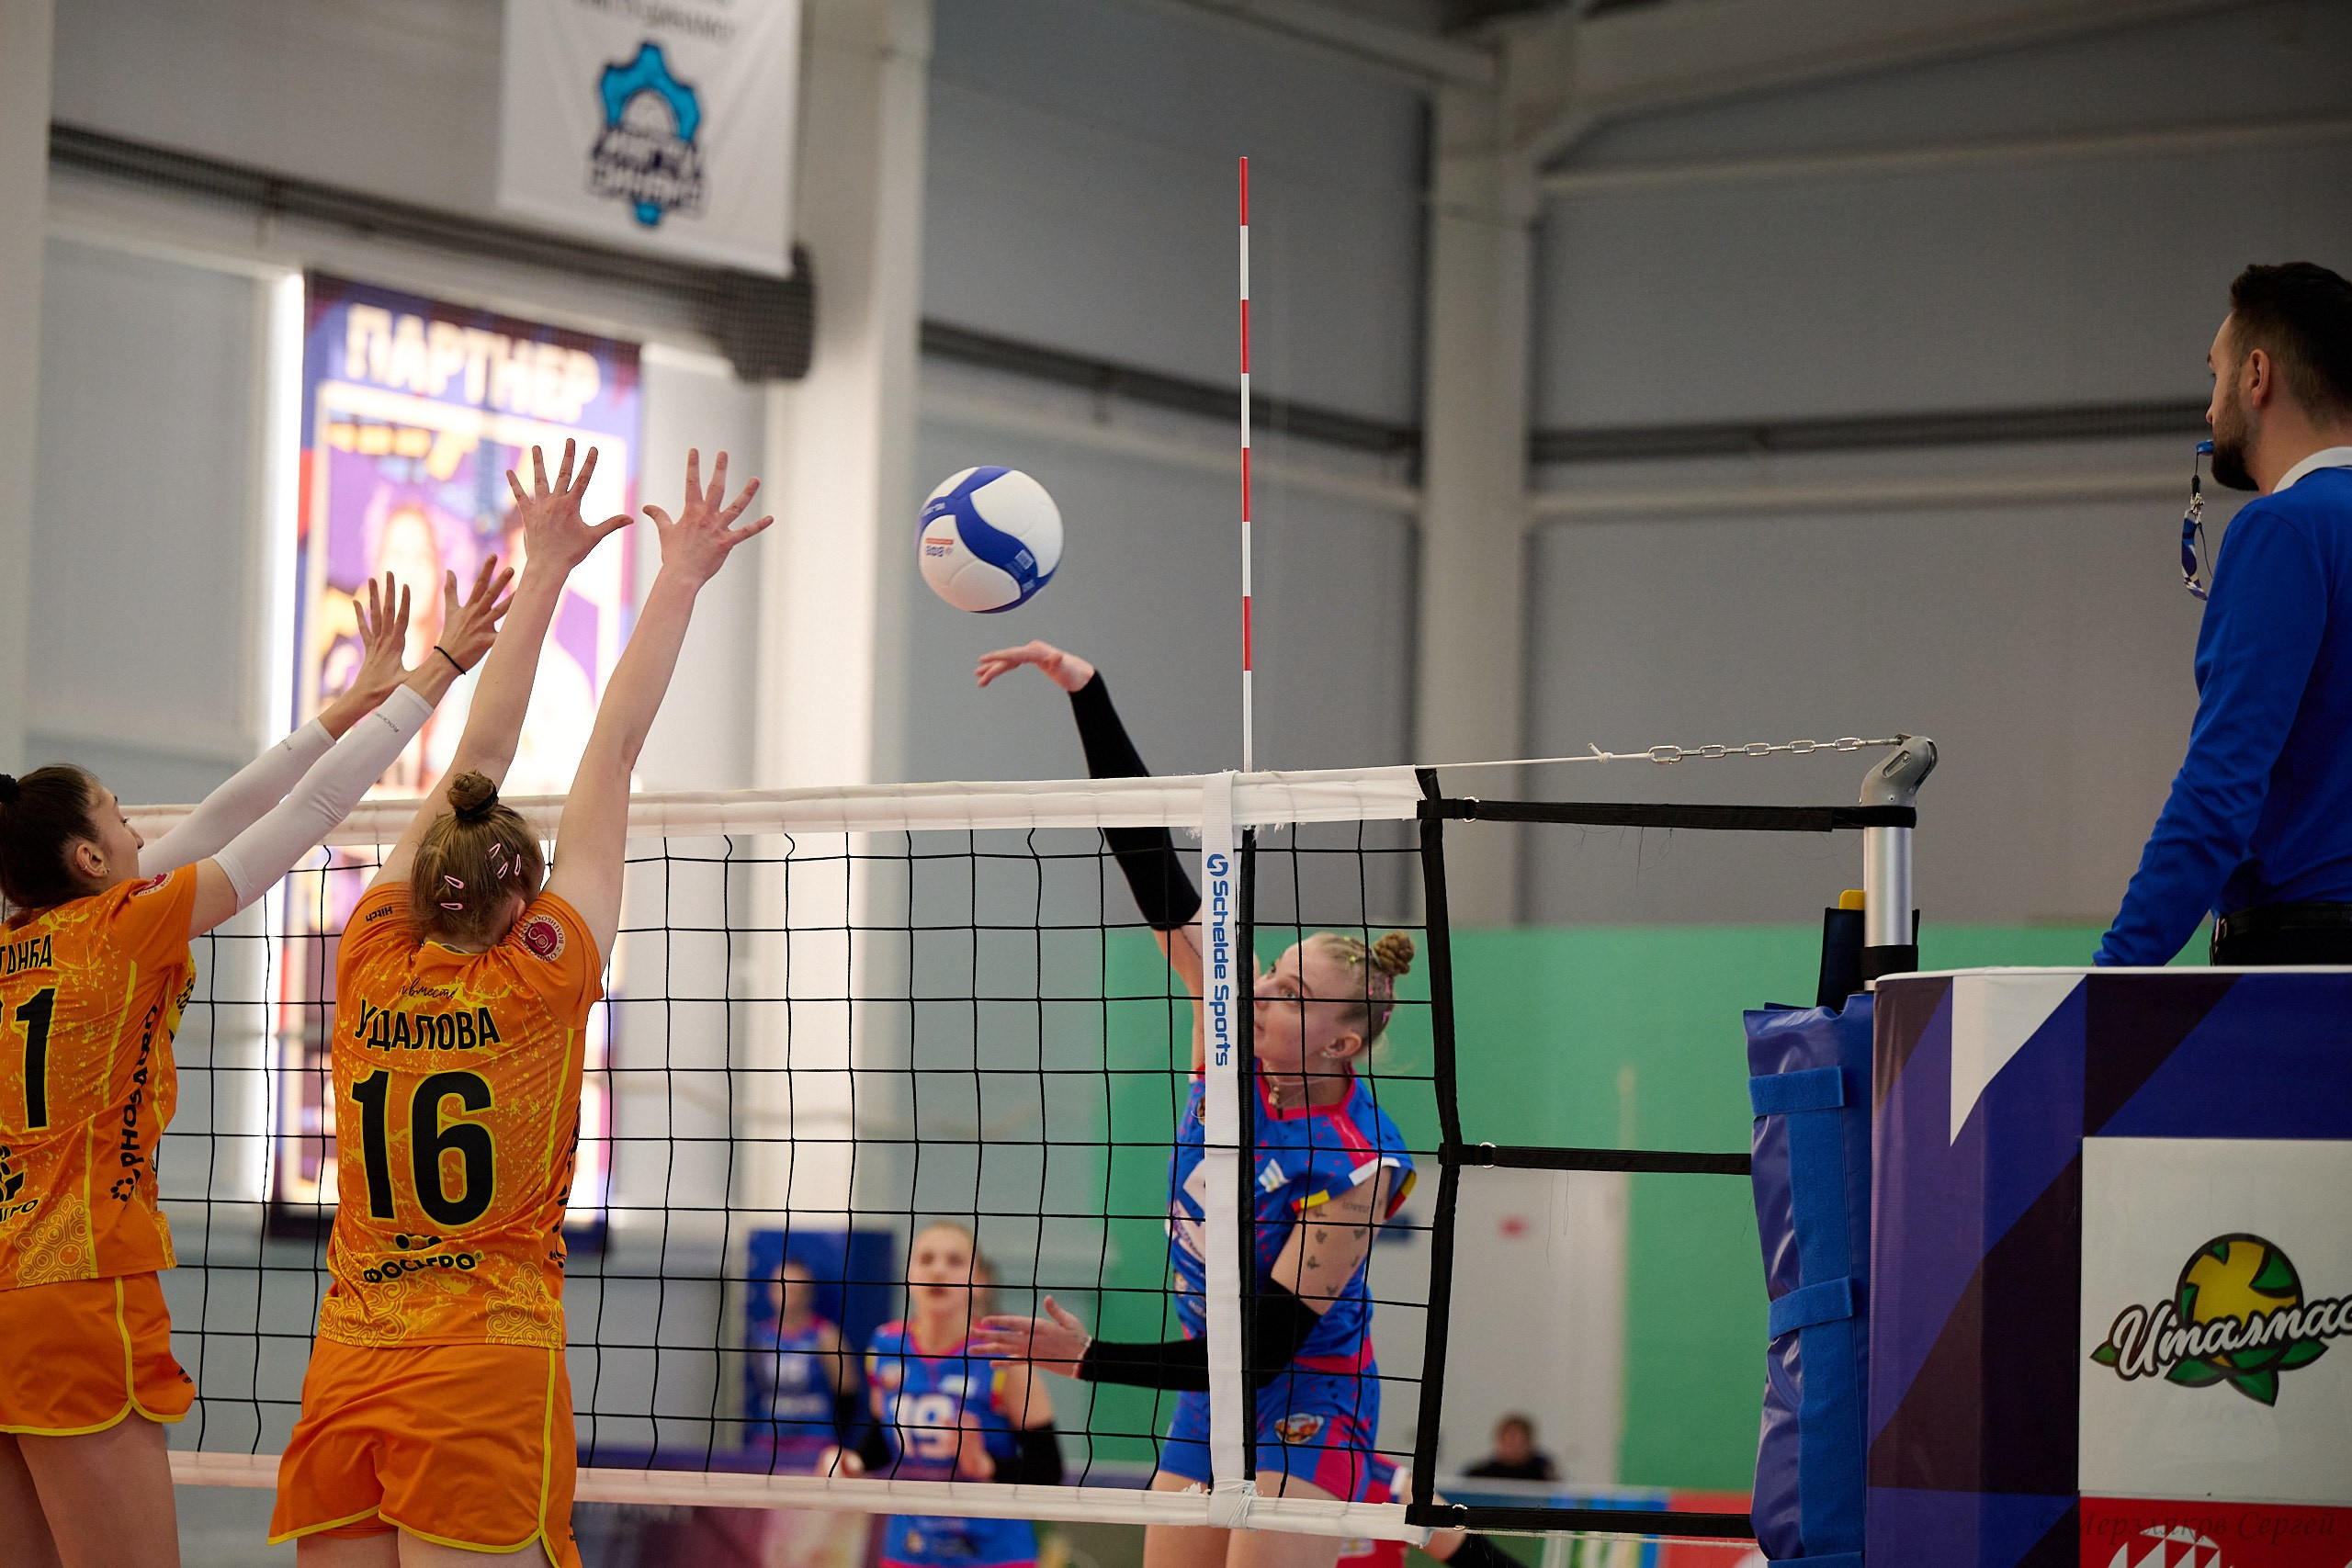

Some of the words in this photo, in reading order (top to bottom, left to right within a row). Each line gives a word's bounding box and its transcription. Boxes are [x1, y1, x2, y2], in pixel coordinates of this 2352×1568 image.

[1213, 880, 1229, 980] Schelde
[0, 987, 56, 1128] 1
[355, 998, 502, 1052] УДАЛОВА
[1209, 985, 1231, 1066] Sports
[352, 1070, 493, 1225] 16
